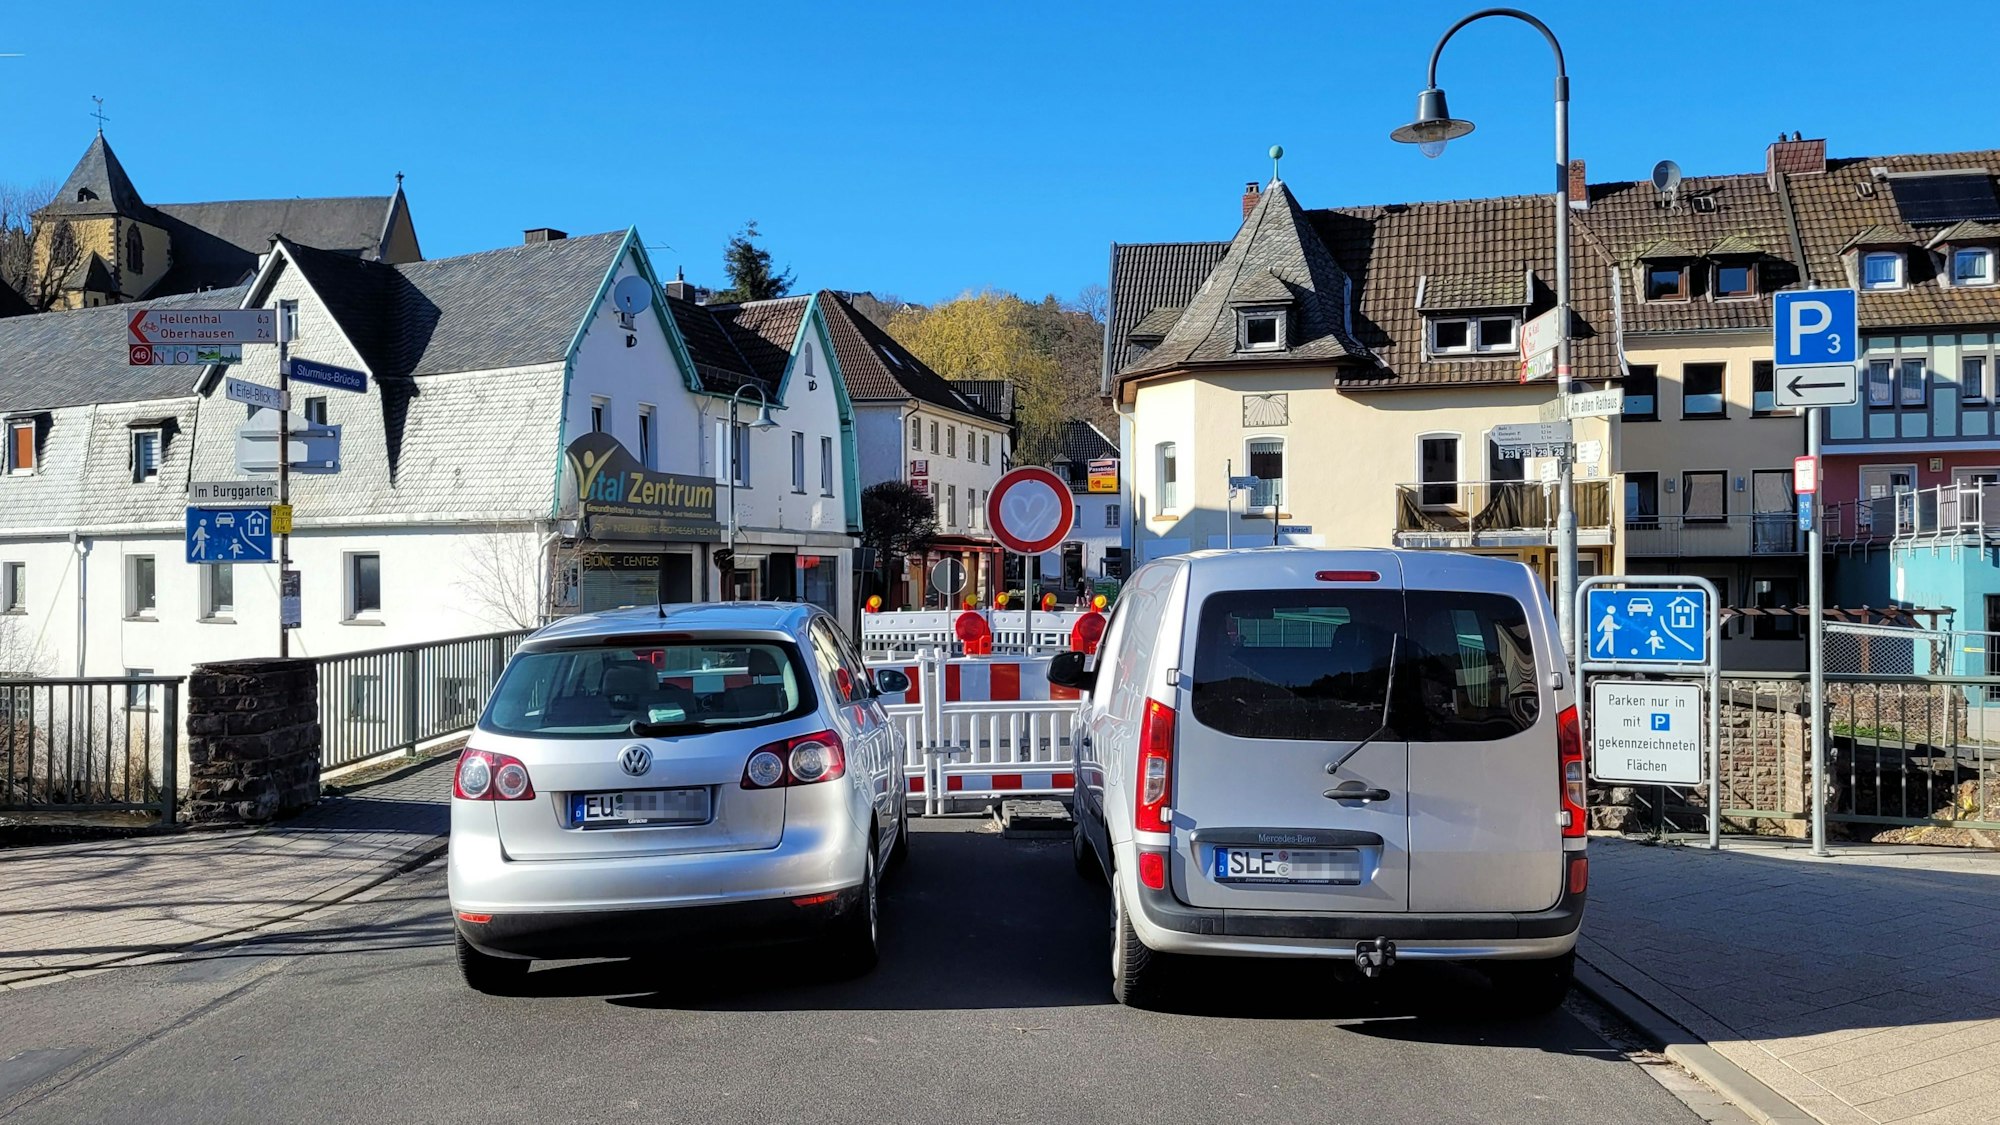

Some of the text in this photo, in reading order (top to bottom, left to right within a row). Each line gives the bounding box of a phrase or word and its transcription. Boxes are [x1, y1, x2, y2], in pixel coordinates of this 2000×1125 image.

[159, 314, 222, 324] Hellenthal
[160, 328, 270, 339] Oberhausen 2,4
[1790, 300, 1841, 356] P 3
[134, 351, 147, 360] 46
[297, 364, 361, 387] Sturmius-Brücke
[236, 383, 271, 405] Eifel-Blick
[1571, 402, 1580, 413] Am
[1581, 397, 1594, 412] alten
[1596, 395, 1617, 411] Rathaus
[1505, 450, 1515, 459] 23
[1538, 449, 1548, 457] 29
[1554, 448, 1565, 456] 28
[194, 484, 273, 500] Im Burggarten
[627, 472, 713, 508] Zentrum
[584, 555, 615, 567] BIONIC
[623, 556, 659, 567] CENTER
[1608, 694, 1685, 708] Parken nur in
[1623, 715, 1666, 729] mit P
[1598, 736, 1696, 752] gekennzeichneten
[1627, 758, 1667, 772] Flächen
[586, 796, 615, 818] EU
[1258, 834, 1318, 843] Mercedes-Benz
[1219, 865, 1224, 873] D
[1230, 851, 1276, 874] SLE
